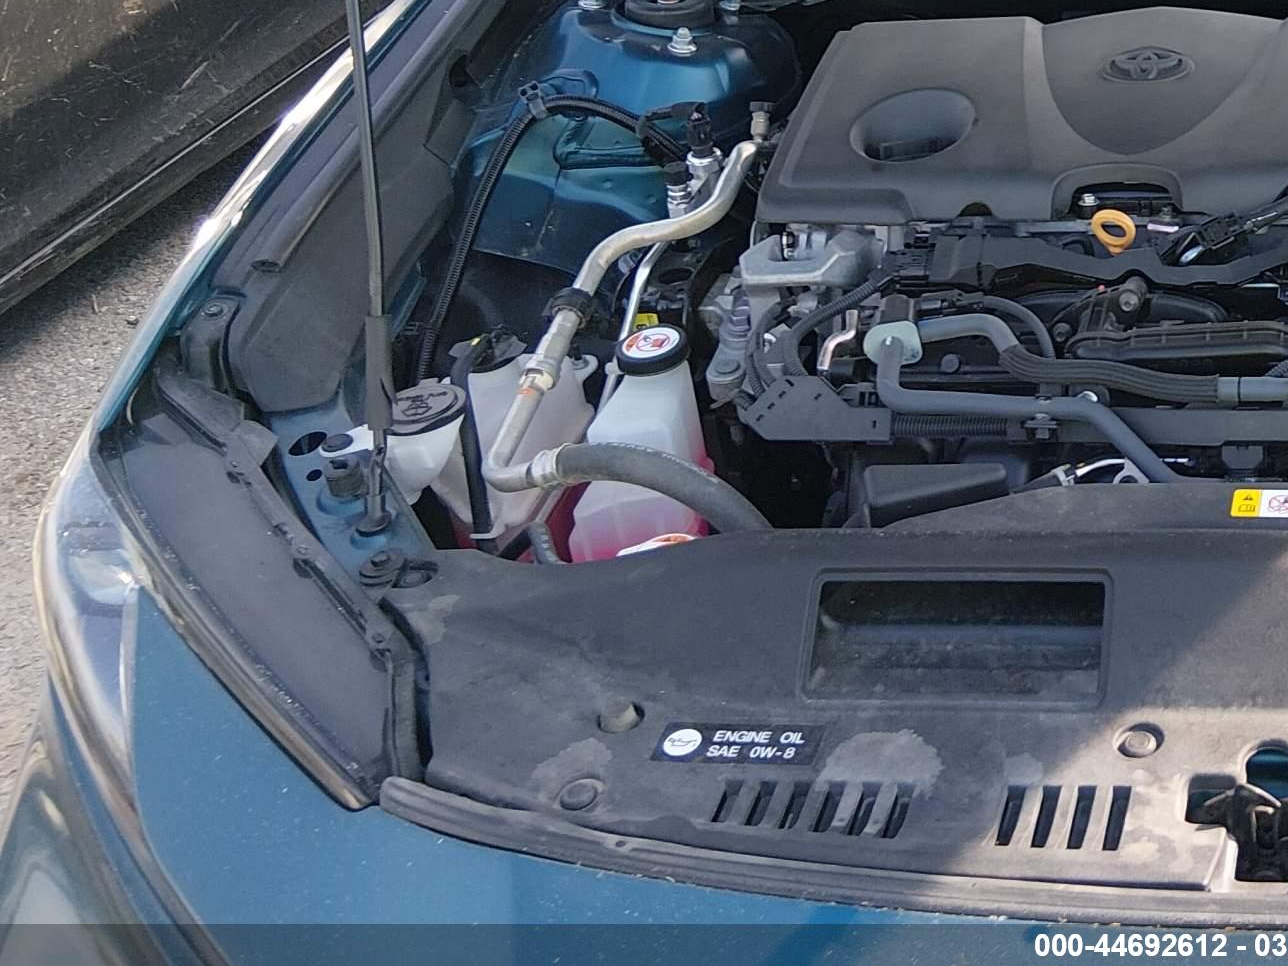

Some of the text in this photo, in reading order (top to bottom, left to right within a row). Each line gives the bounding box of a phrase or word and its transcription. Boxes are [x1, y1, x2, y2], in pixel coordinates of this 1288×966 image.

[713, 730, 806, 744] ENGINE OIL
[706, 745, 796, 759] SAE 0W-8
